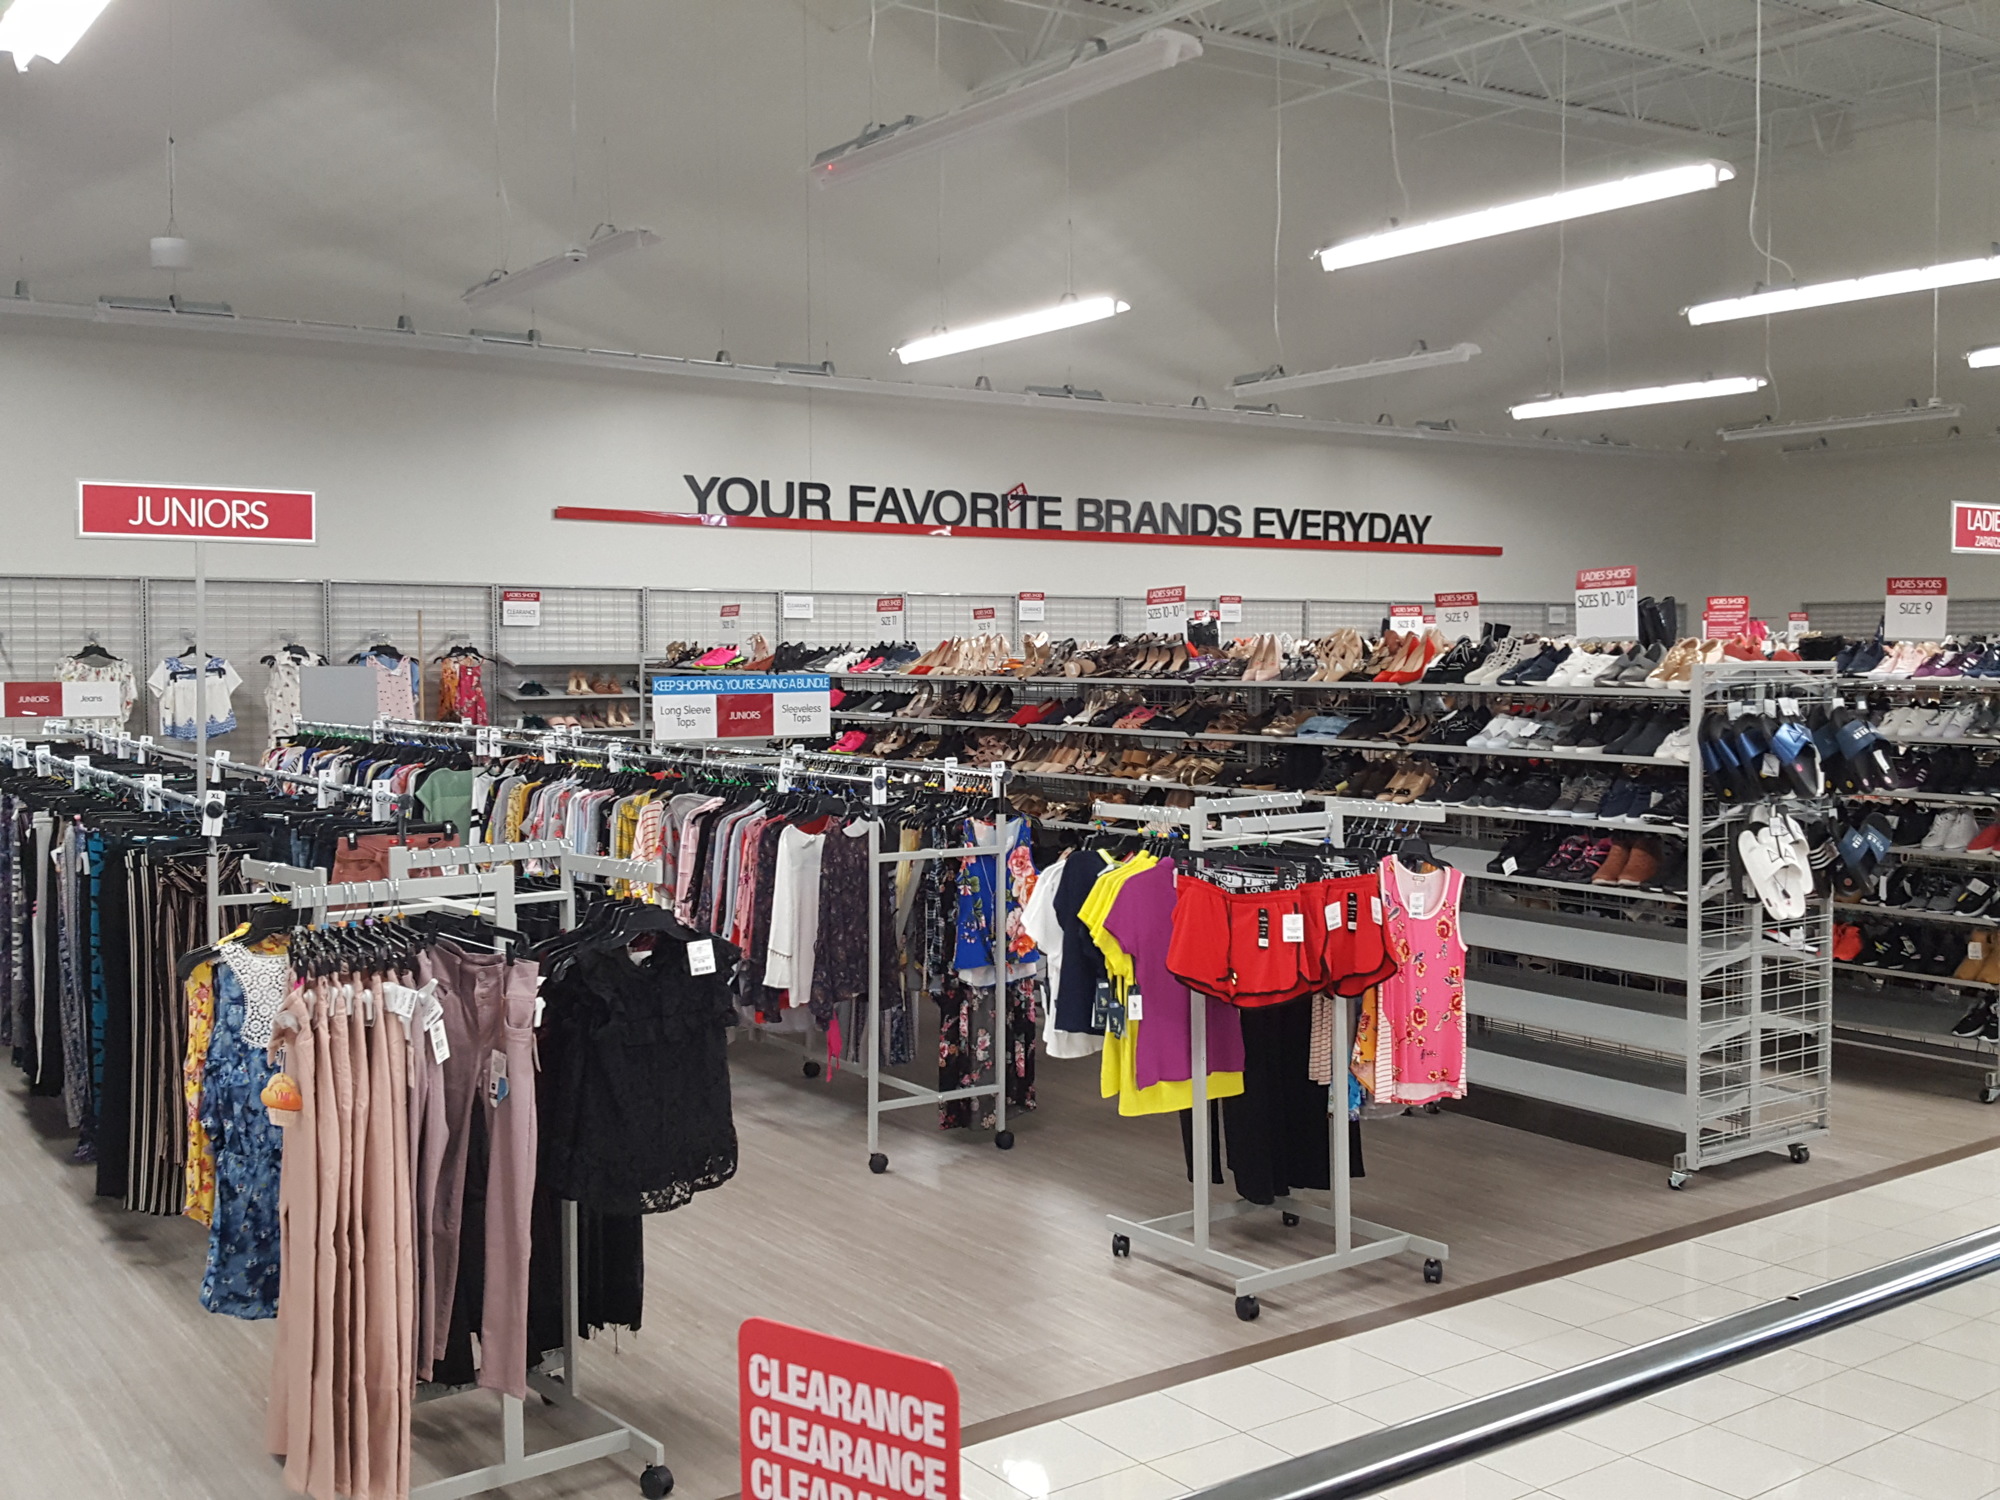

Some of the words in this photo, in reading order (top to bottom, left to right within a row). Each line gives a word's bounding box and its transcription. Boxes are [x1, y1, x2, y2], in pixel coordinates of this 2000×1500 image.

[128, 496, 269, 530] JUNIORS
[683, 474, 832, 520] YOUR
[850, 485, 1062, 530] FAVORITE
[1077, 497, 1242, 538] BRANDS
[1254, 507, 1432, 545] EVERYDAY
[1581, 570, 1605, 582] LADIES
[1606, 568, 1631, 580] SHOES
[1891, 579, 1916, 588] LADIES
[1917, 580, 1942, 588] SHOES
[1149, 589, 1166, 599] LADIES
[1166, 587, 1182, 597] SHOES
[1438, 594, 1456, 602] LADIES
[1456, 593, 1475, 601] SHOES
[1578, 594, 1599, 608] SIZES
[1899, 602, 1922, 615] SIZE
[1925, 601, 1933, 614] 9
[1445, 612, 1461, 623] SIZE
[1463, 611, 1469, 622] 9
[654, 680, 676, 692] KEEP
[676, 679, 725, 691] SHOPPING,
[757, 678, 788, 689] SAVING
[789, 678, 796, 689] A
[797, 677, 829, 689] BUNDLE
[80, 695, 103, 703] Jeans
[660, 705, 681, 717] Long
[684, 705, 711, 715] Sleeve
[782, 704, 821, 714] Sleeveless
[728, 711, 761, 720] JUNIORS
[793, 714, 811, 724] Tops
[676, 718, 696, 728] Tops
[1340, 870, 1361, 878] LOVE
[1244, 885, 1271, 894] LOVE
[749, 1353, 947, 1449] CLEARANCE
[749, 1406, 947, 1500] CLEARANCE
